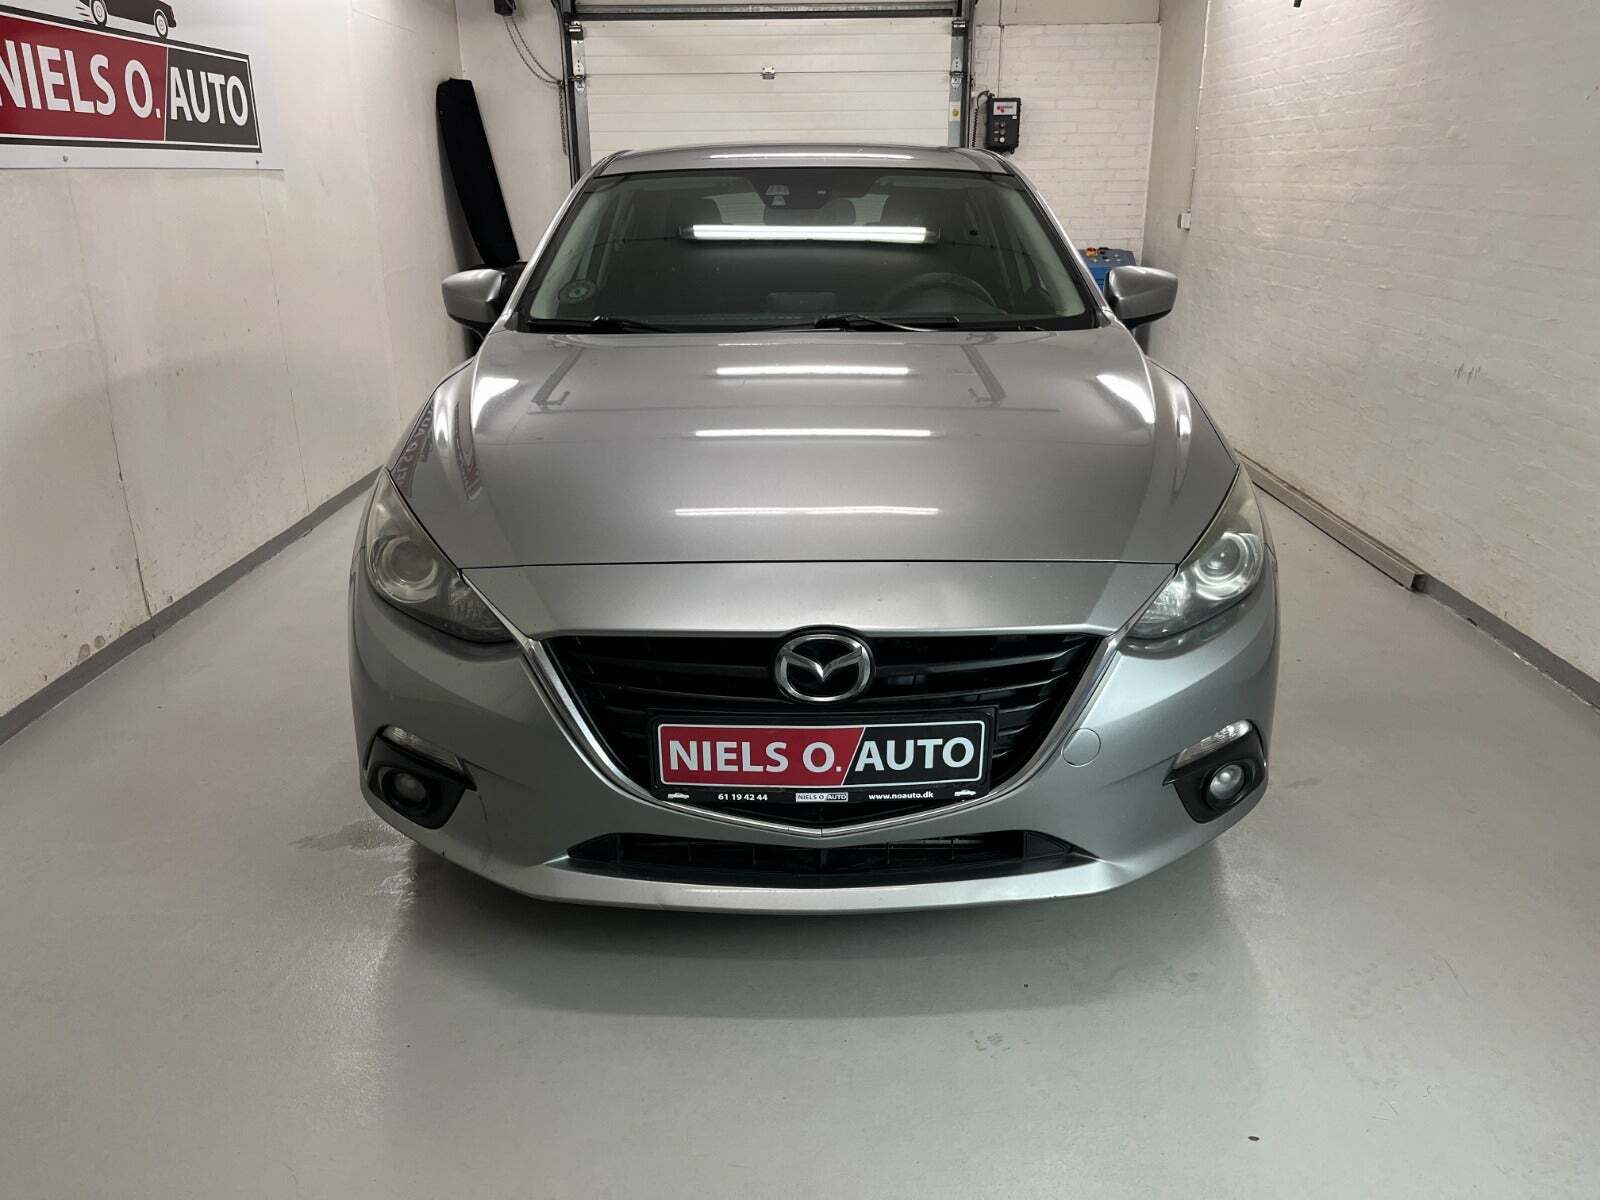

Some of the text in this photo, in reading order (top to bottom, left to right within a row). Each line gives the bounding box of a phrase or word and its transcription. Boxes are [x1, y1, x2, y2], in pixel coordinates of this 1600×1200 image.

[0, 40, 249, 126] NIELS O. AUTO
[669, 736, 975, 773] NIELS O. AUTO
[718, 793, 728, 801] 61
[731, 793, 742, 801] 19
[868, 791, 933, 800] www.noauto.dk
